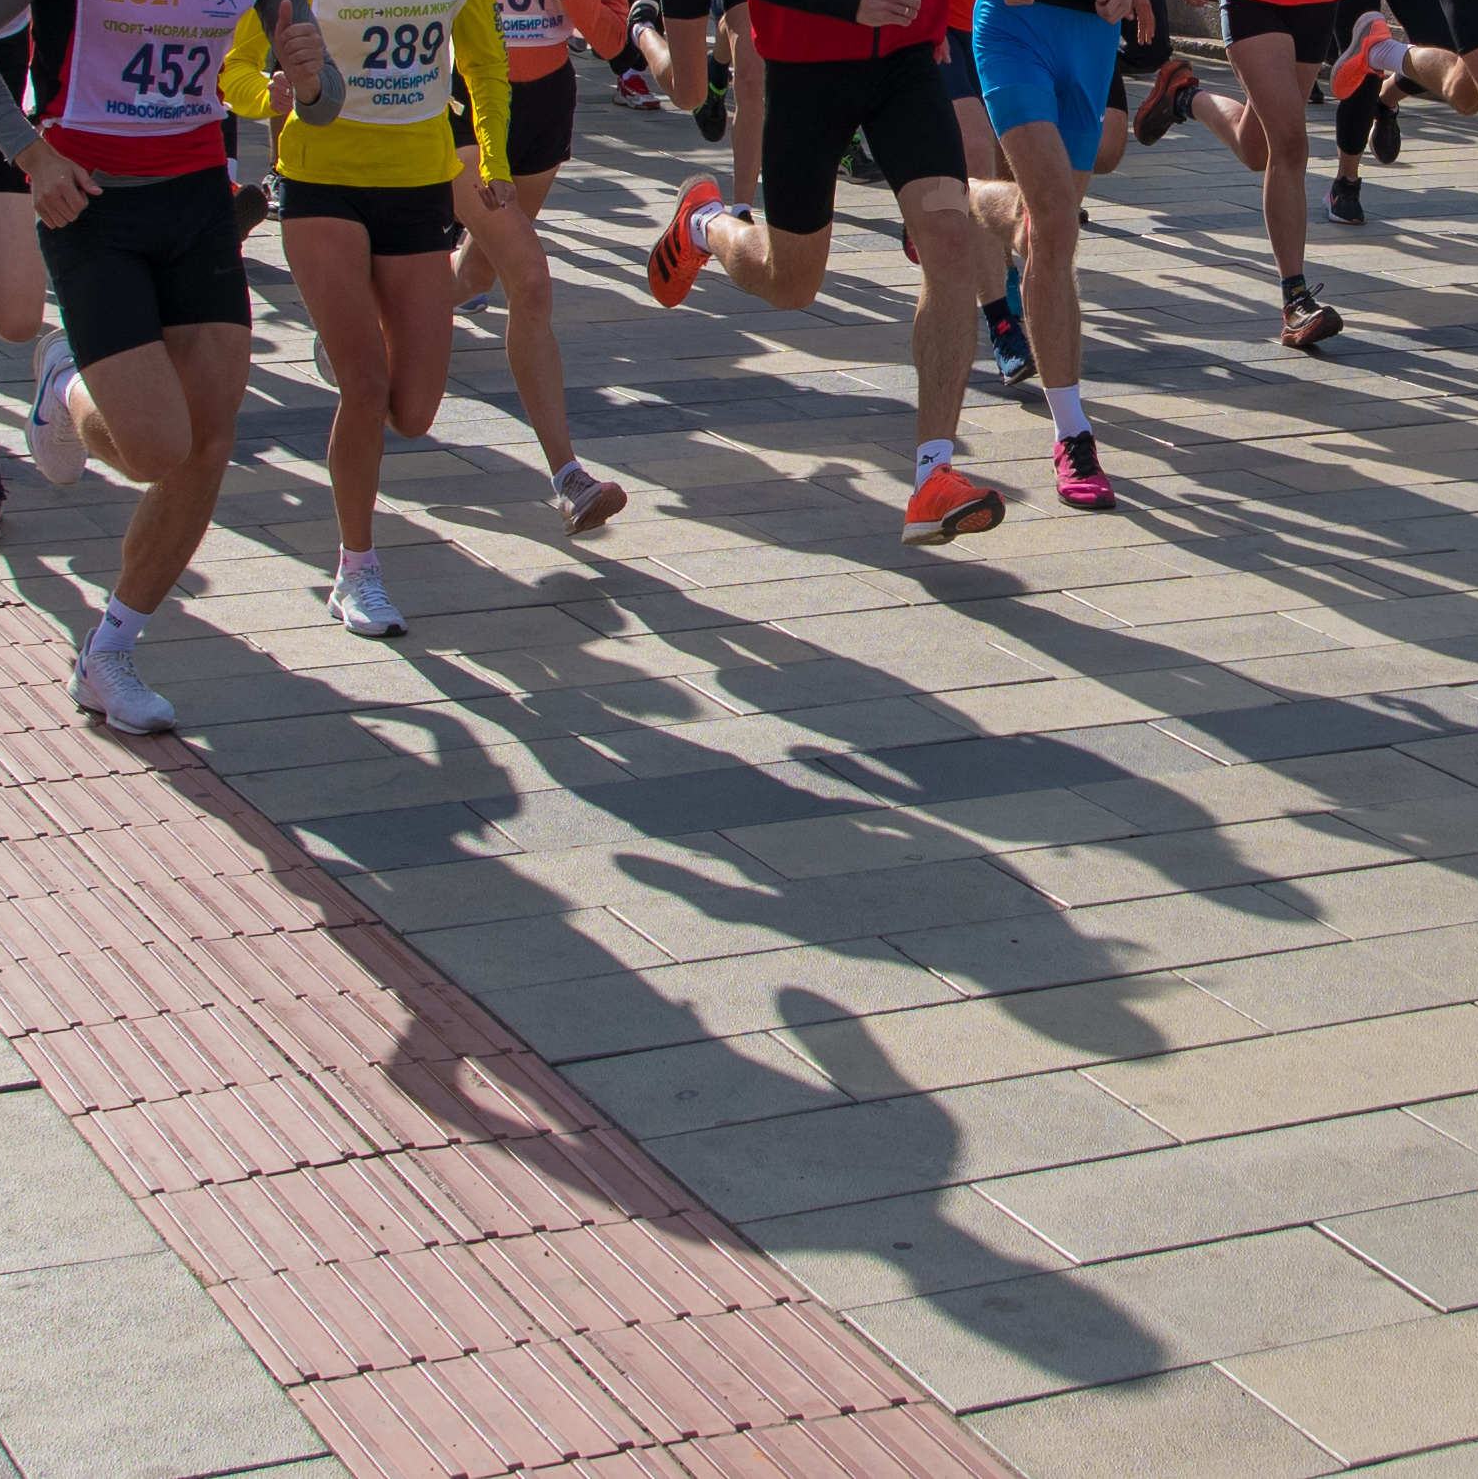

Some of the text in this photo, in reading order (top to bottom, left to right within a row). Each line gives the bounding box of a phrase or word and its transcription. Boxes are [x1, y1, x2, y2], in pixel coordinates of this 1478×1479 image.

[338, 7, 375, 20] СПОРТ
[384, 4, 428, 18] НОРМА
[103, 20, 143, 34] СПОРТ
[153, 25, 198, 38] НОРМА
[362, 21, 444, 69] 289
[122, 43, 210, 98] 452
[106, 100, 212, 119] НОВОСИБИРСКАЯ
